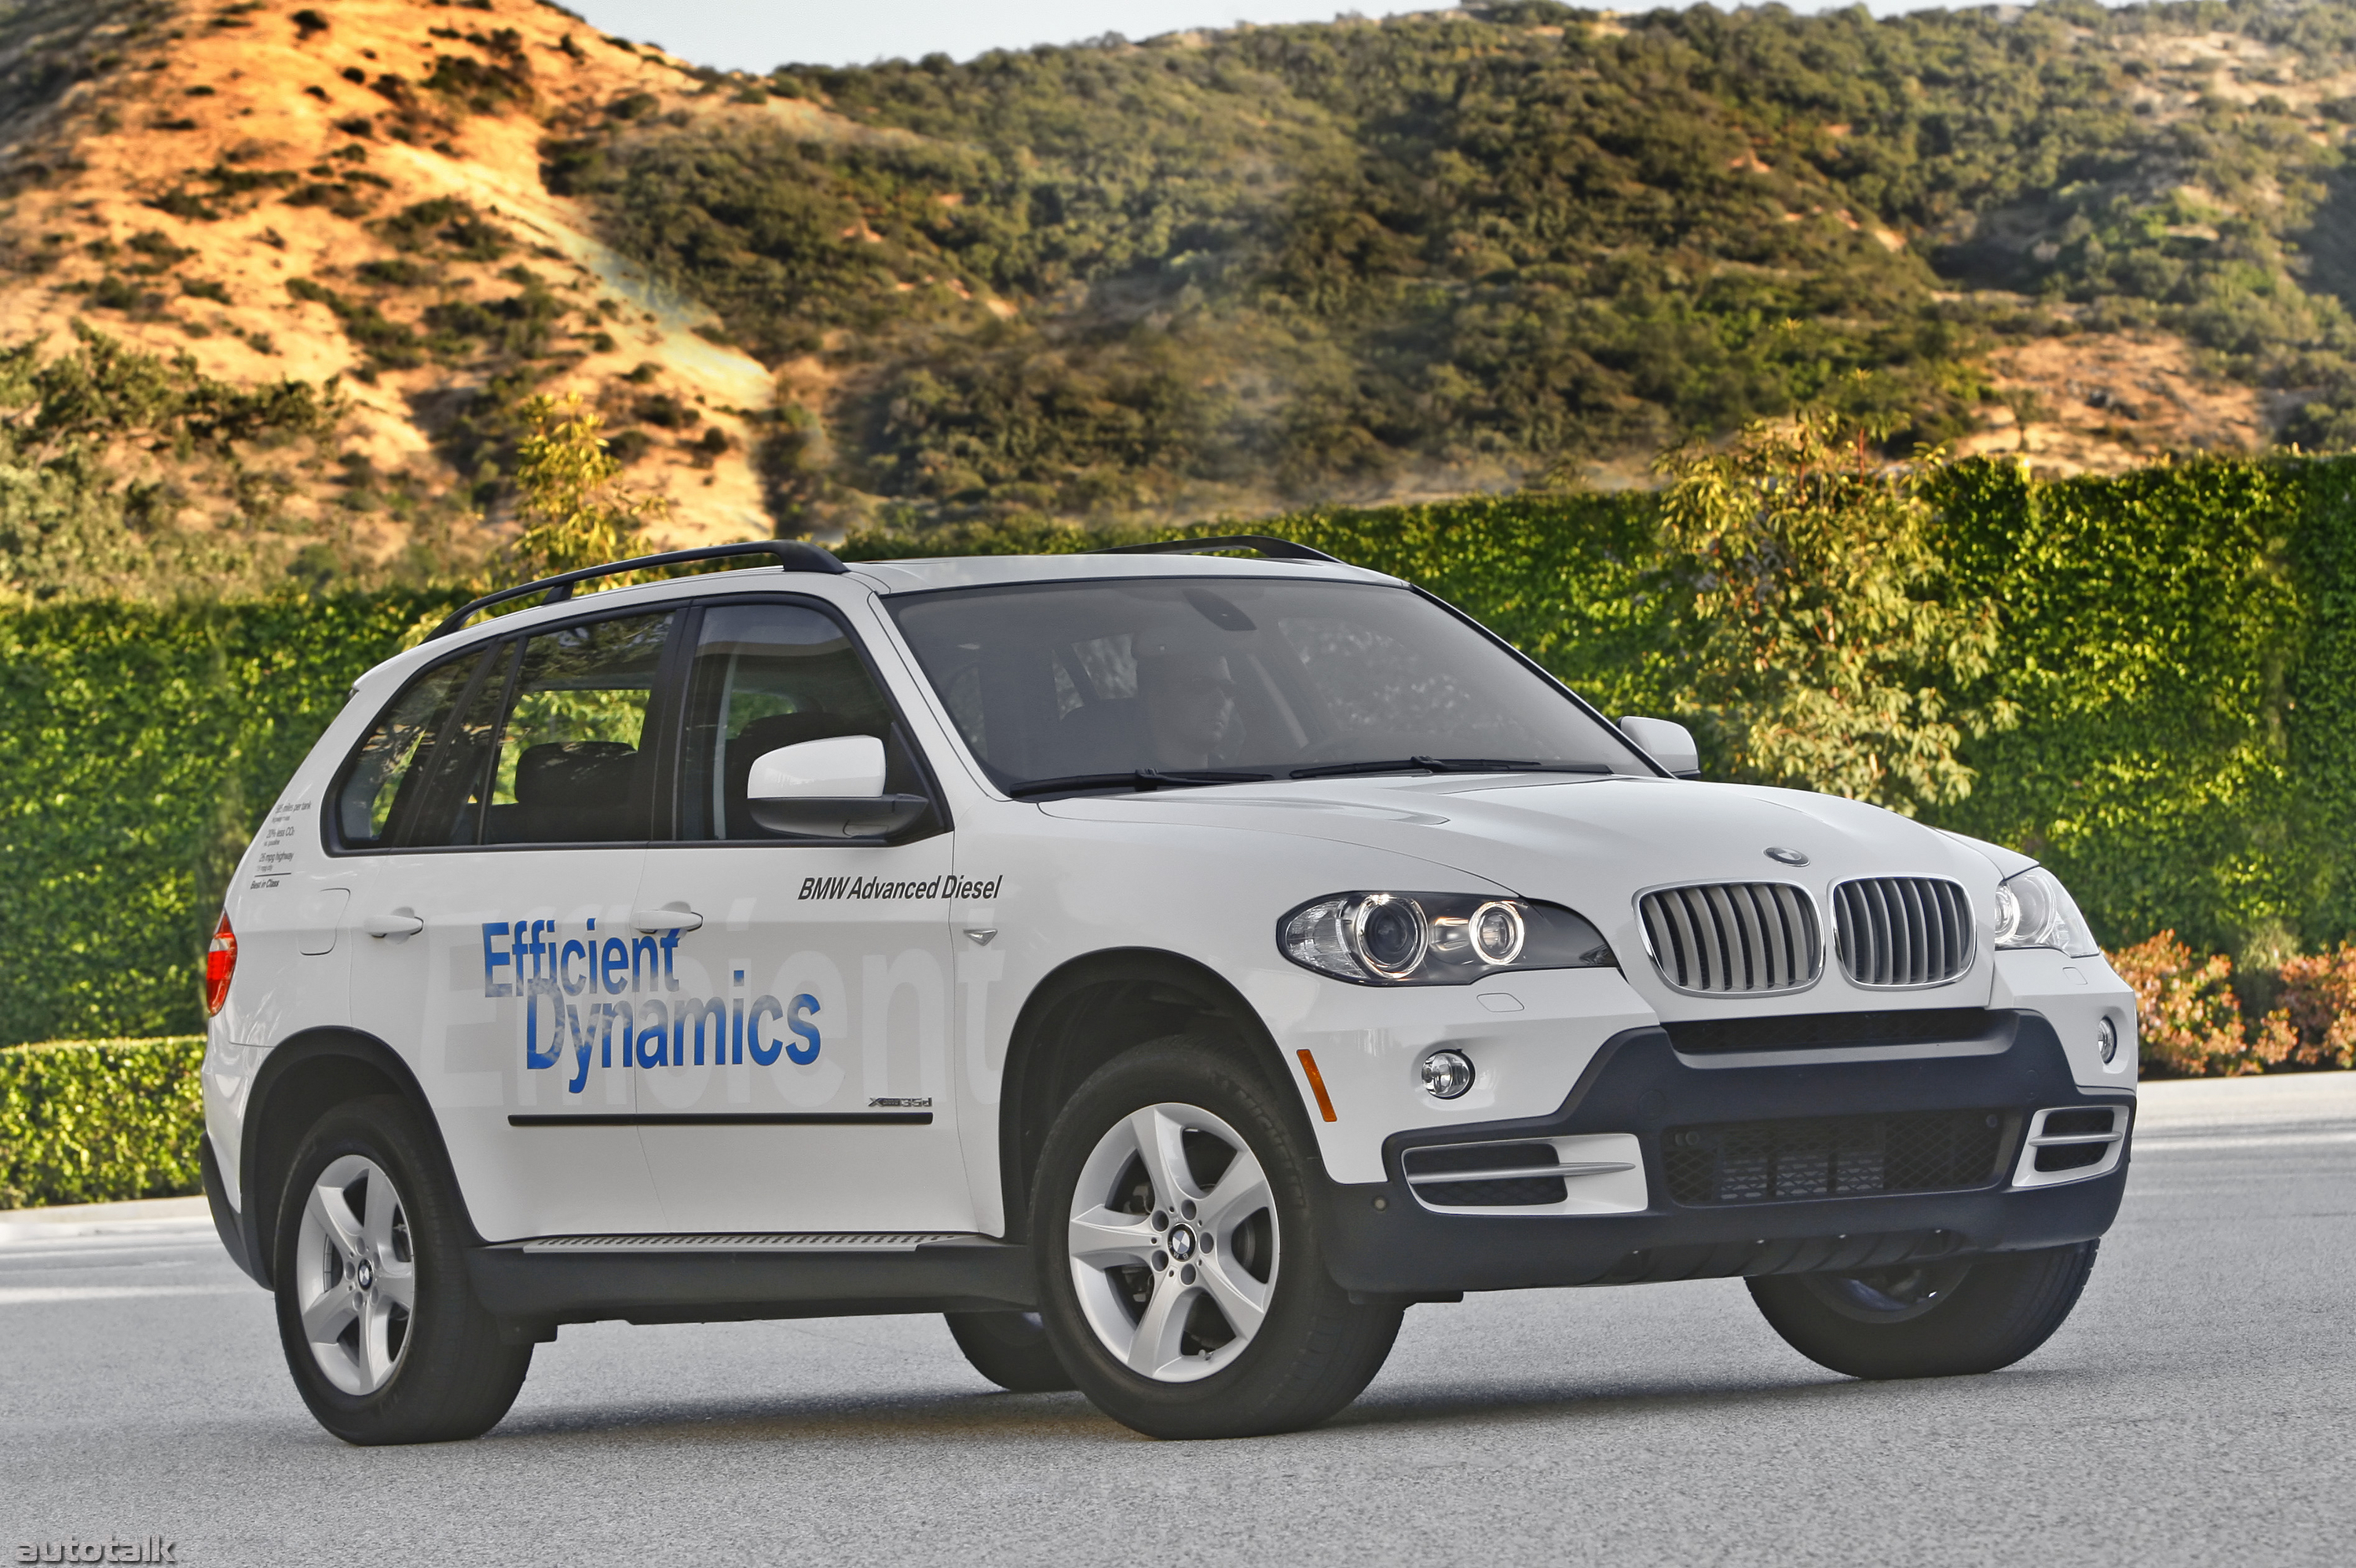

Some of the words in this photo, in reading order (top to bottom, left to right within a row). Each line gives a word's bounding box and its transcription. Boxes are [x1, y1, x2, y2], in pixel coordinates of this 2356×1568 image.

[250, 879, 262, 889] Best
[266, 879, 280, 888] Class
[798, 876, 851, 900] BMW
[847, 875, 942, 900] Advanced
[941, 875, 1004, 899] Diesel
[481, 917, 681, 998] Efficient
[526, 970, 821, 1094] Dynamics
